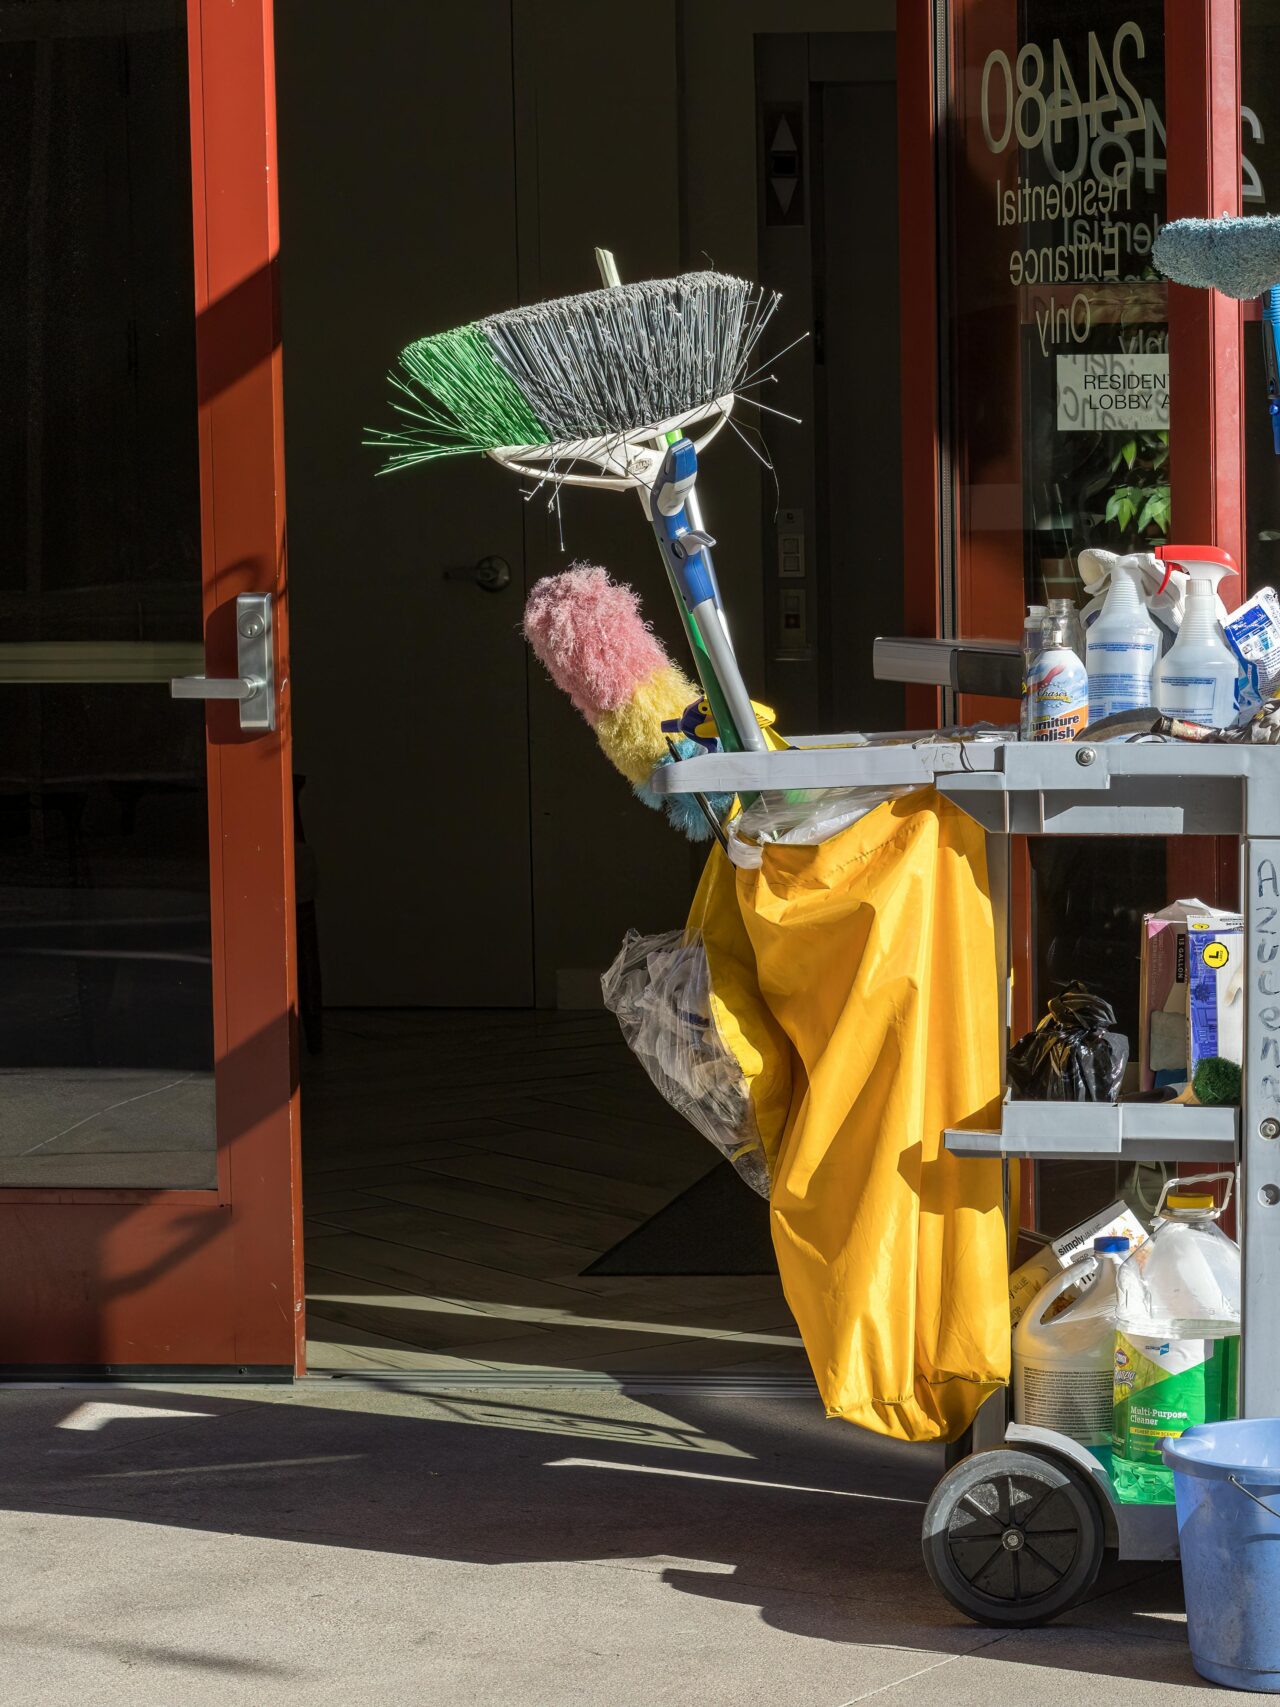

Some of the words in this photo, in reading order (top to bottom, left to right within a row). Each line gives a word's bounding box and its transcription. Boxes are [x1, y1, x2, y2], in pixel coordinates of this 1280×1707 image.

[1084, 374, 1170, 390] RESIDEN
[1089, 394, 1153, 410] LOBBY
[1032, 715, 1079, 731] urniture
[1177, 947, 1185, 979] GALLON
[1058, 1235, 1085, 1256] simply
[1130, 1405, 1188, 1420] Multi-Purpose
[1130, 1414, 1159, 1426] Cleaner
